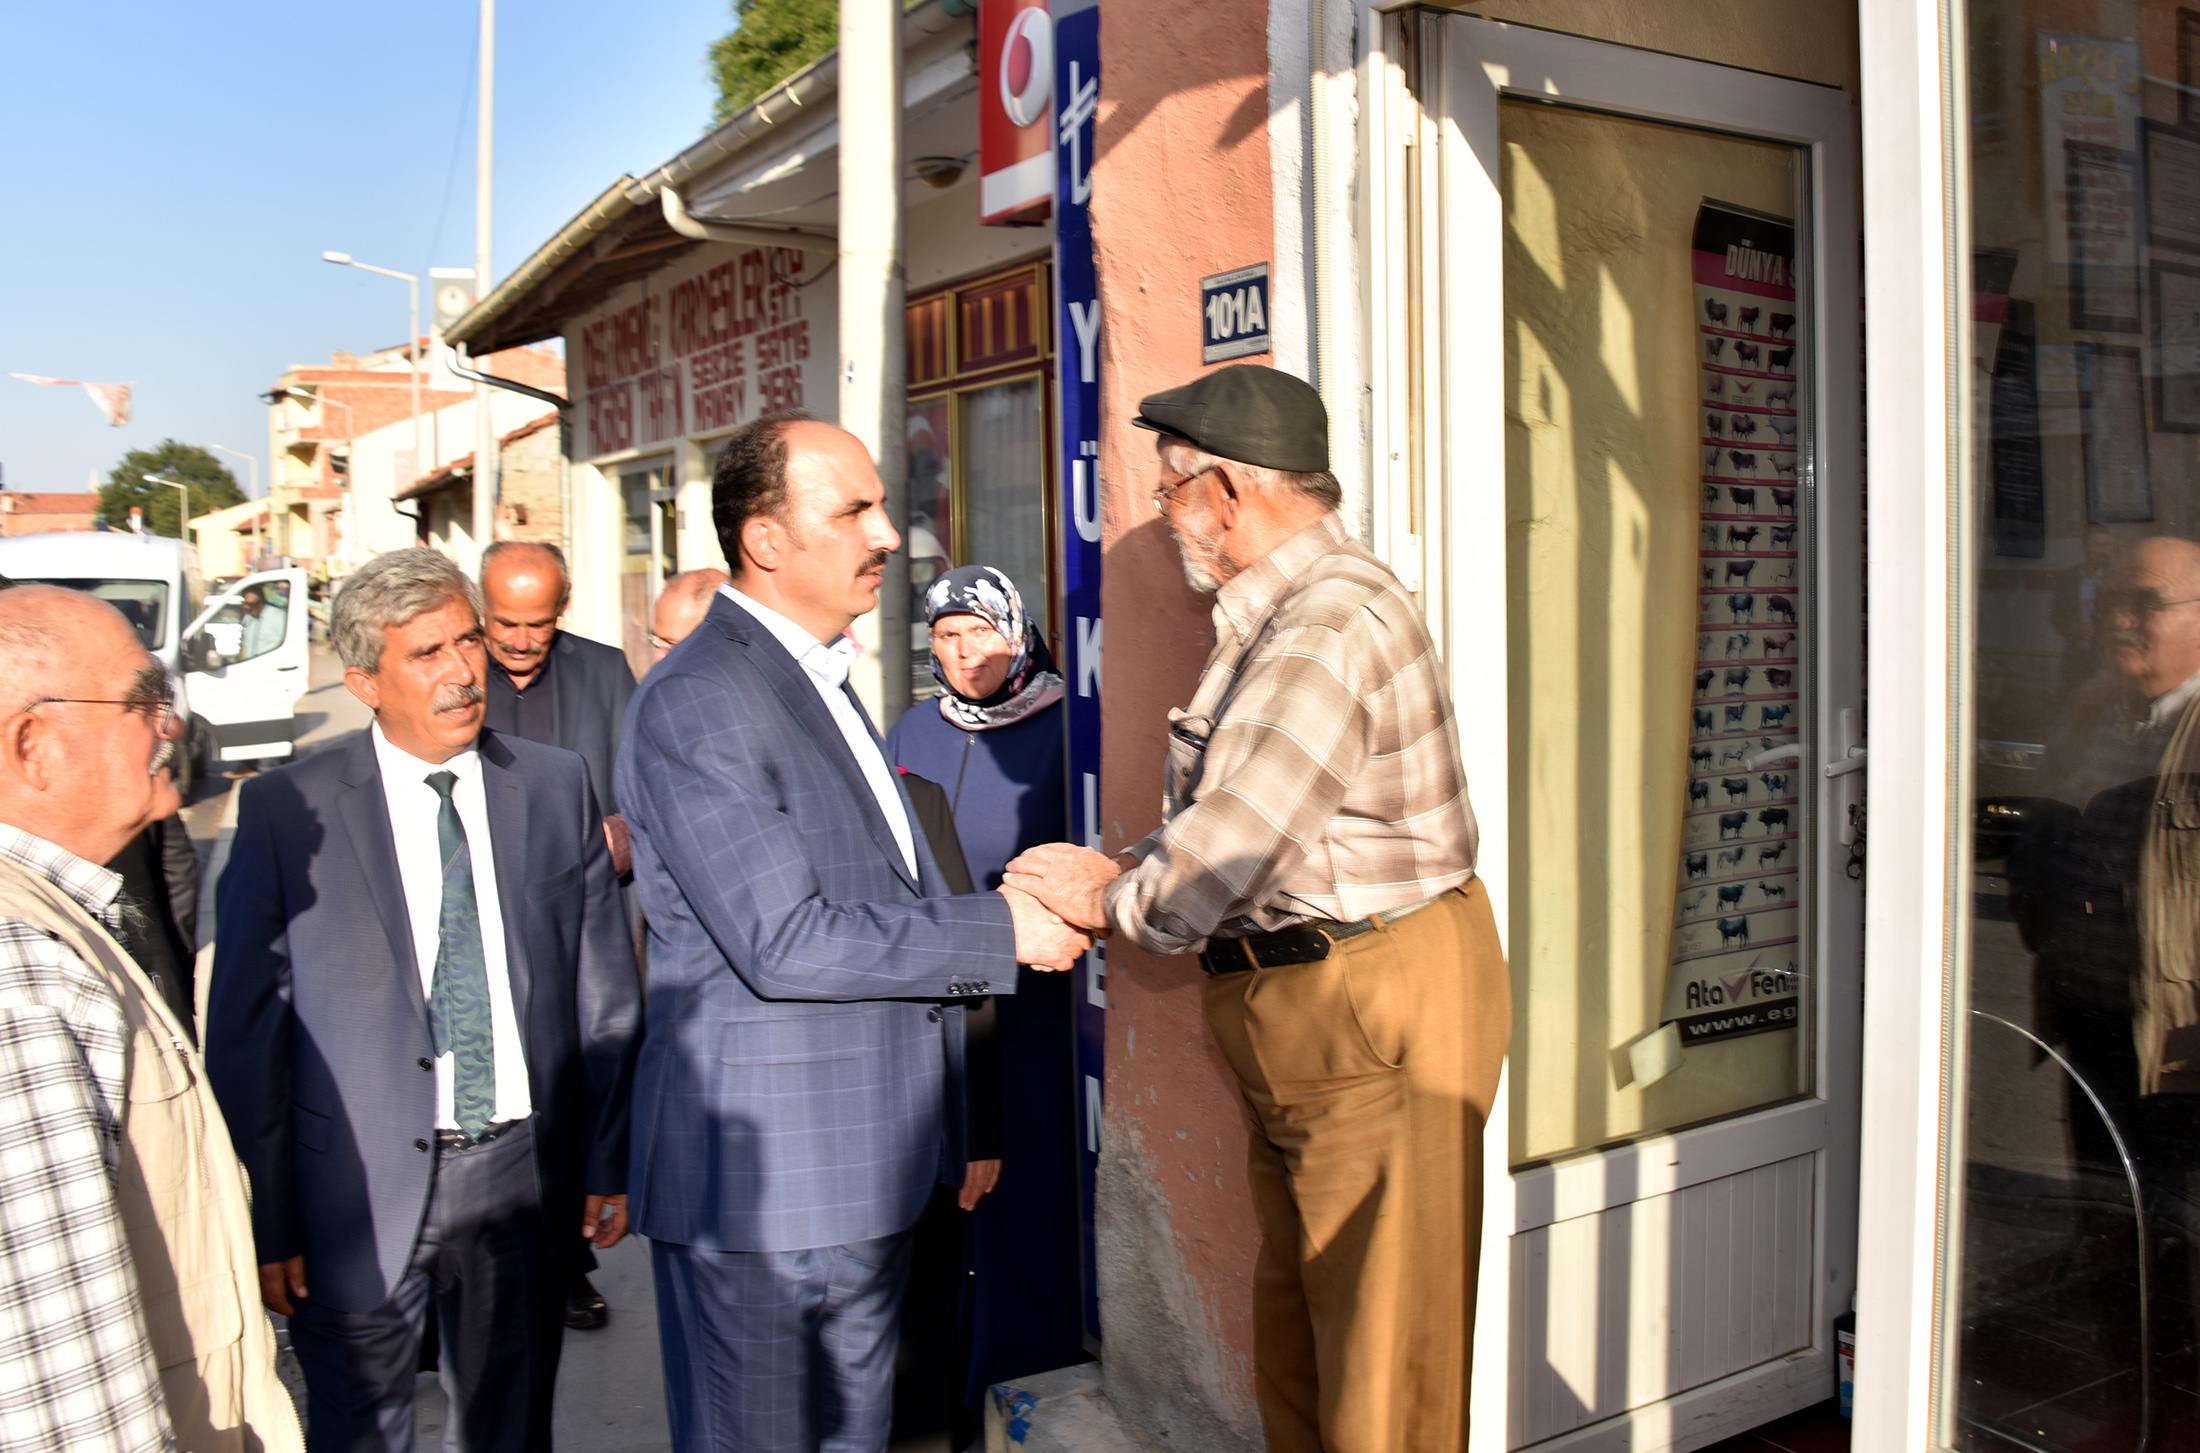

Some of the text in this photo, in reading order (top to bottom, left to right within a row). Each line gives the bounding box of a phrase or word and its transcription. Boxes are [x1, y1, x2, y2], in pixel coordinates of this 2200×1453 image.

[1725, 238, 1784, 287] DÜNYA
[1205, 285, 1266, 341] 101A
[1686, 970, 1788, 1010] Ata Fen
